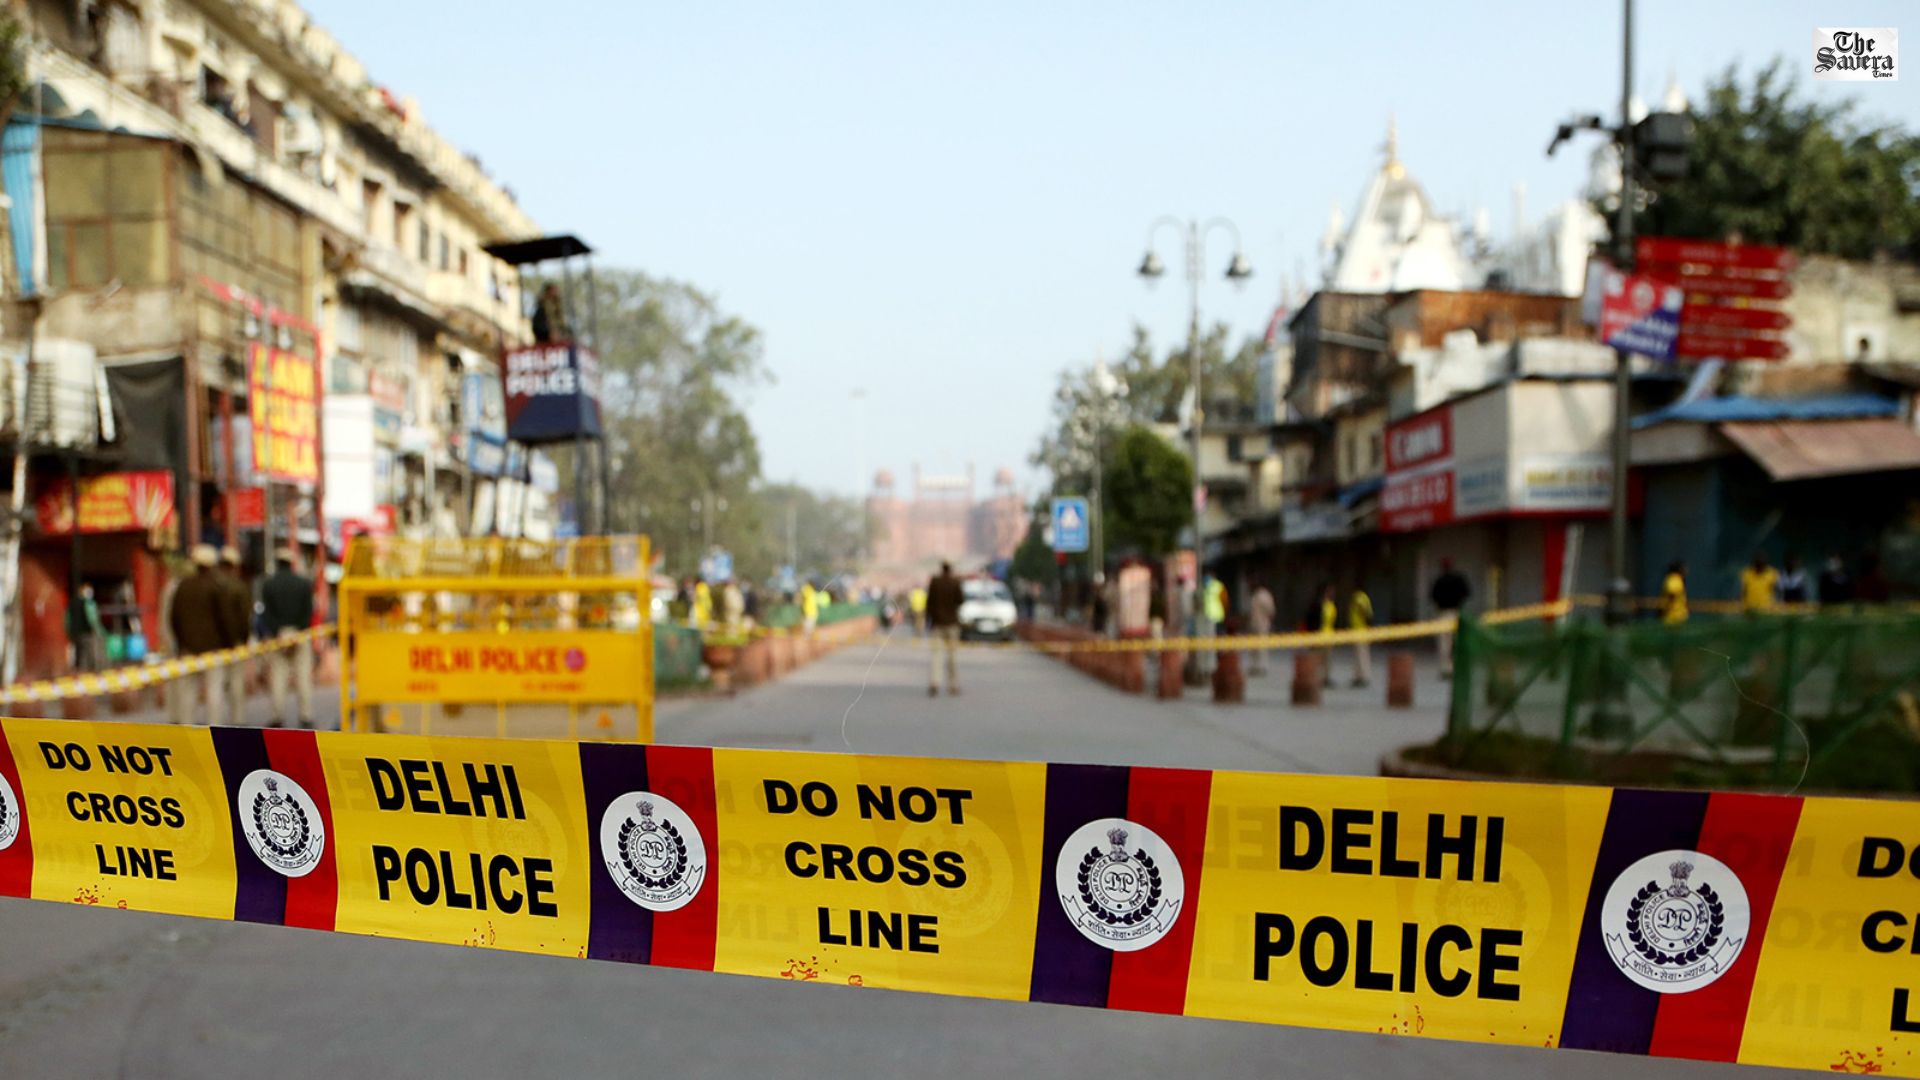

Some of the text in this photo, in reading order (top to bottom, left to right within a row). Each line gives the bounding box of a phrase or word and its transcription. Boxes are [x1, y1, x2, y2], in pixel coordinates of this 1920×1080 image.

[506, 367, 576, 398] POLICE
[410, 646, 559, 675] DELHI POLICE
[38, 741, 173, 776] DO NOT
[66, 791, 185, 829] CROSS
[365, 757, 526, 820] DELHI
[763, 779, 972, 825] DO NOT
[95, 844, 177, 881] LINE
[785, 842, 967, 889] CROSS
[1279, 806, 1505, 883] DELHI
[372, 845, 558, 918] POLICE
[818, 907, 939, 954] LINE
[1861, 910, 1920, 955] C
[1253, 912, 1523, 1001] POLICE
